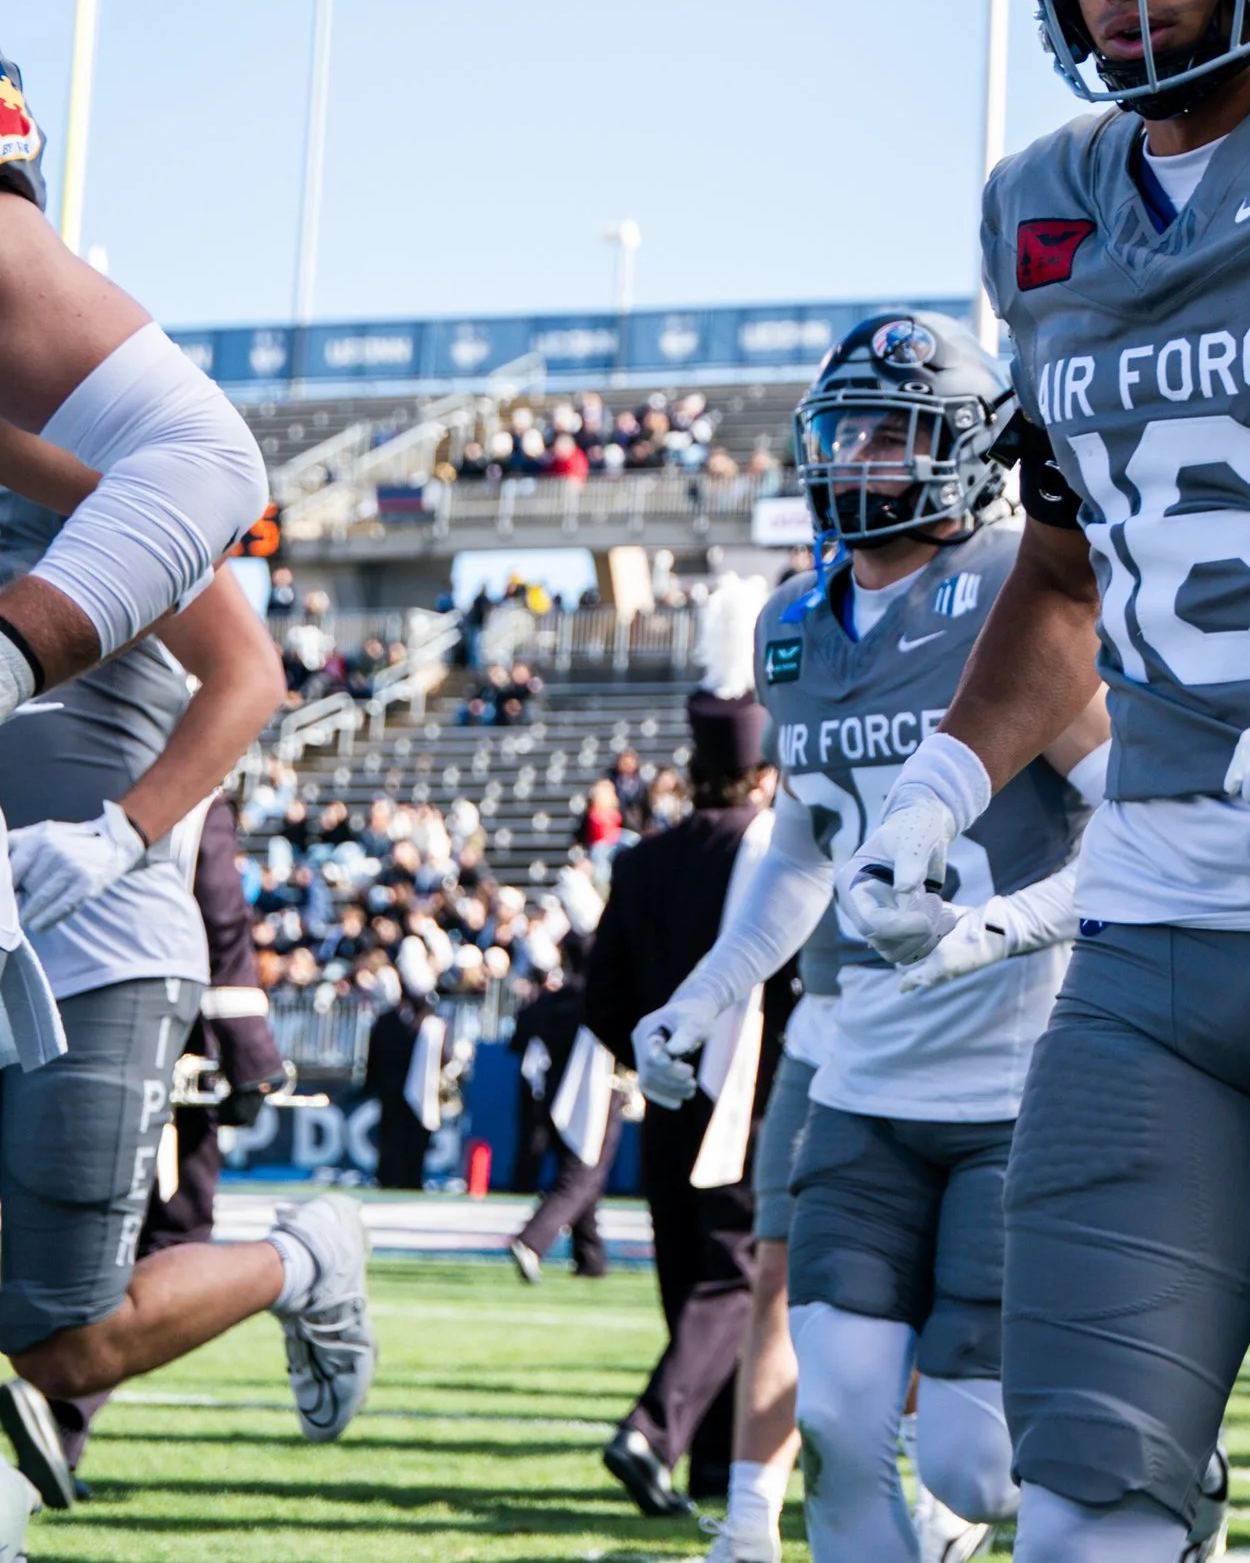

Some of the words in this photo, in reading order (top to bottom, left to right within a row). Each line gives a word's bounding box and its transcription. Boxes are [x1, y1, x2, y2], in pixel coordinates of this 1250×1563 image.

[1038, 355, 1095, 425] AIR
[779, 722, 808, 766] AIR
[819, 708, 948, 763] FORCE
